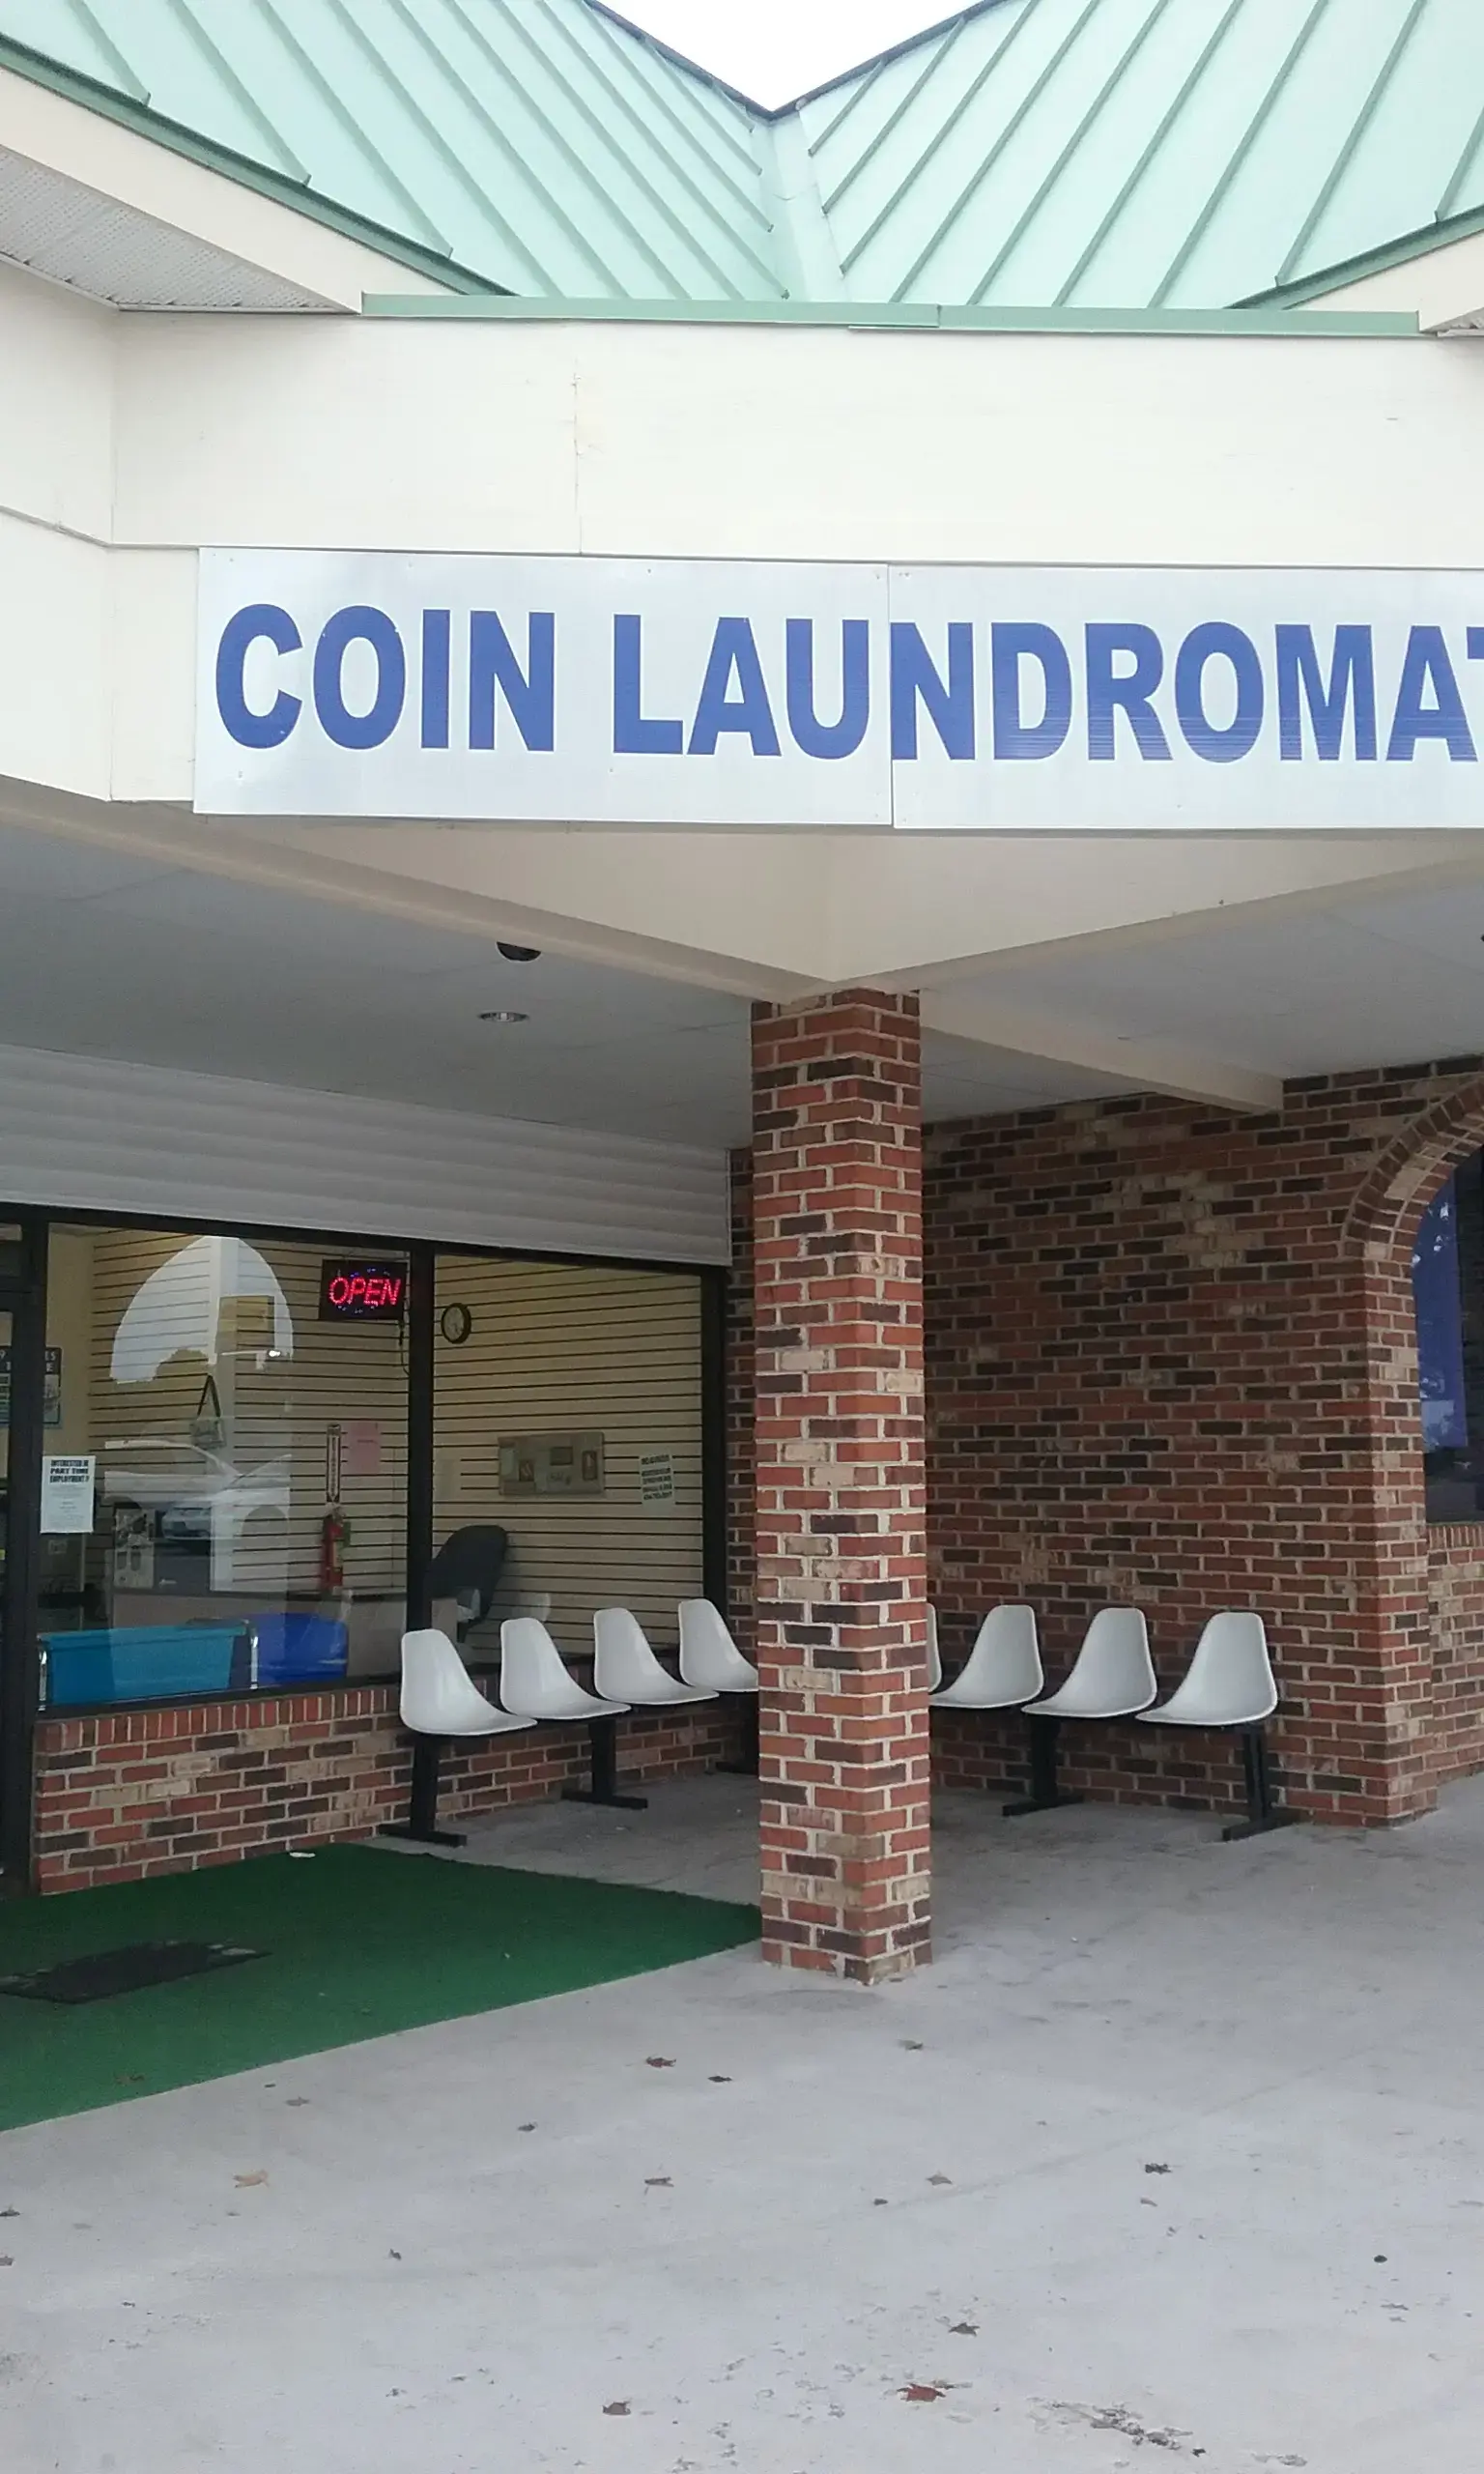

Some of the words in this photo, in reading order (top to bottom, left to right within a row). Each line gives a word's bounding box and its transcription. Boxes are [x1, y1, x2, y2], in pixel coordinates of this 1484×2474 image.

[216, 604, 555, 751] COIN
[614, 615, 1484, 762] LAUNDROMA
[328, 1278, 401, 1306] OPEN
